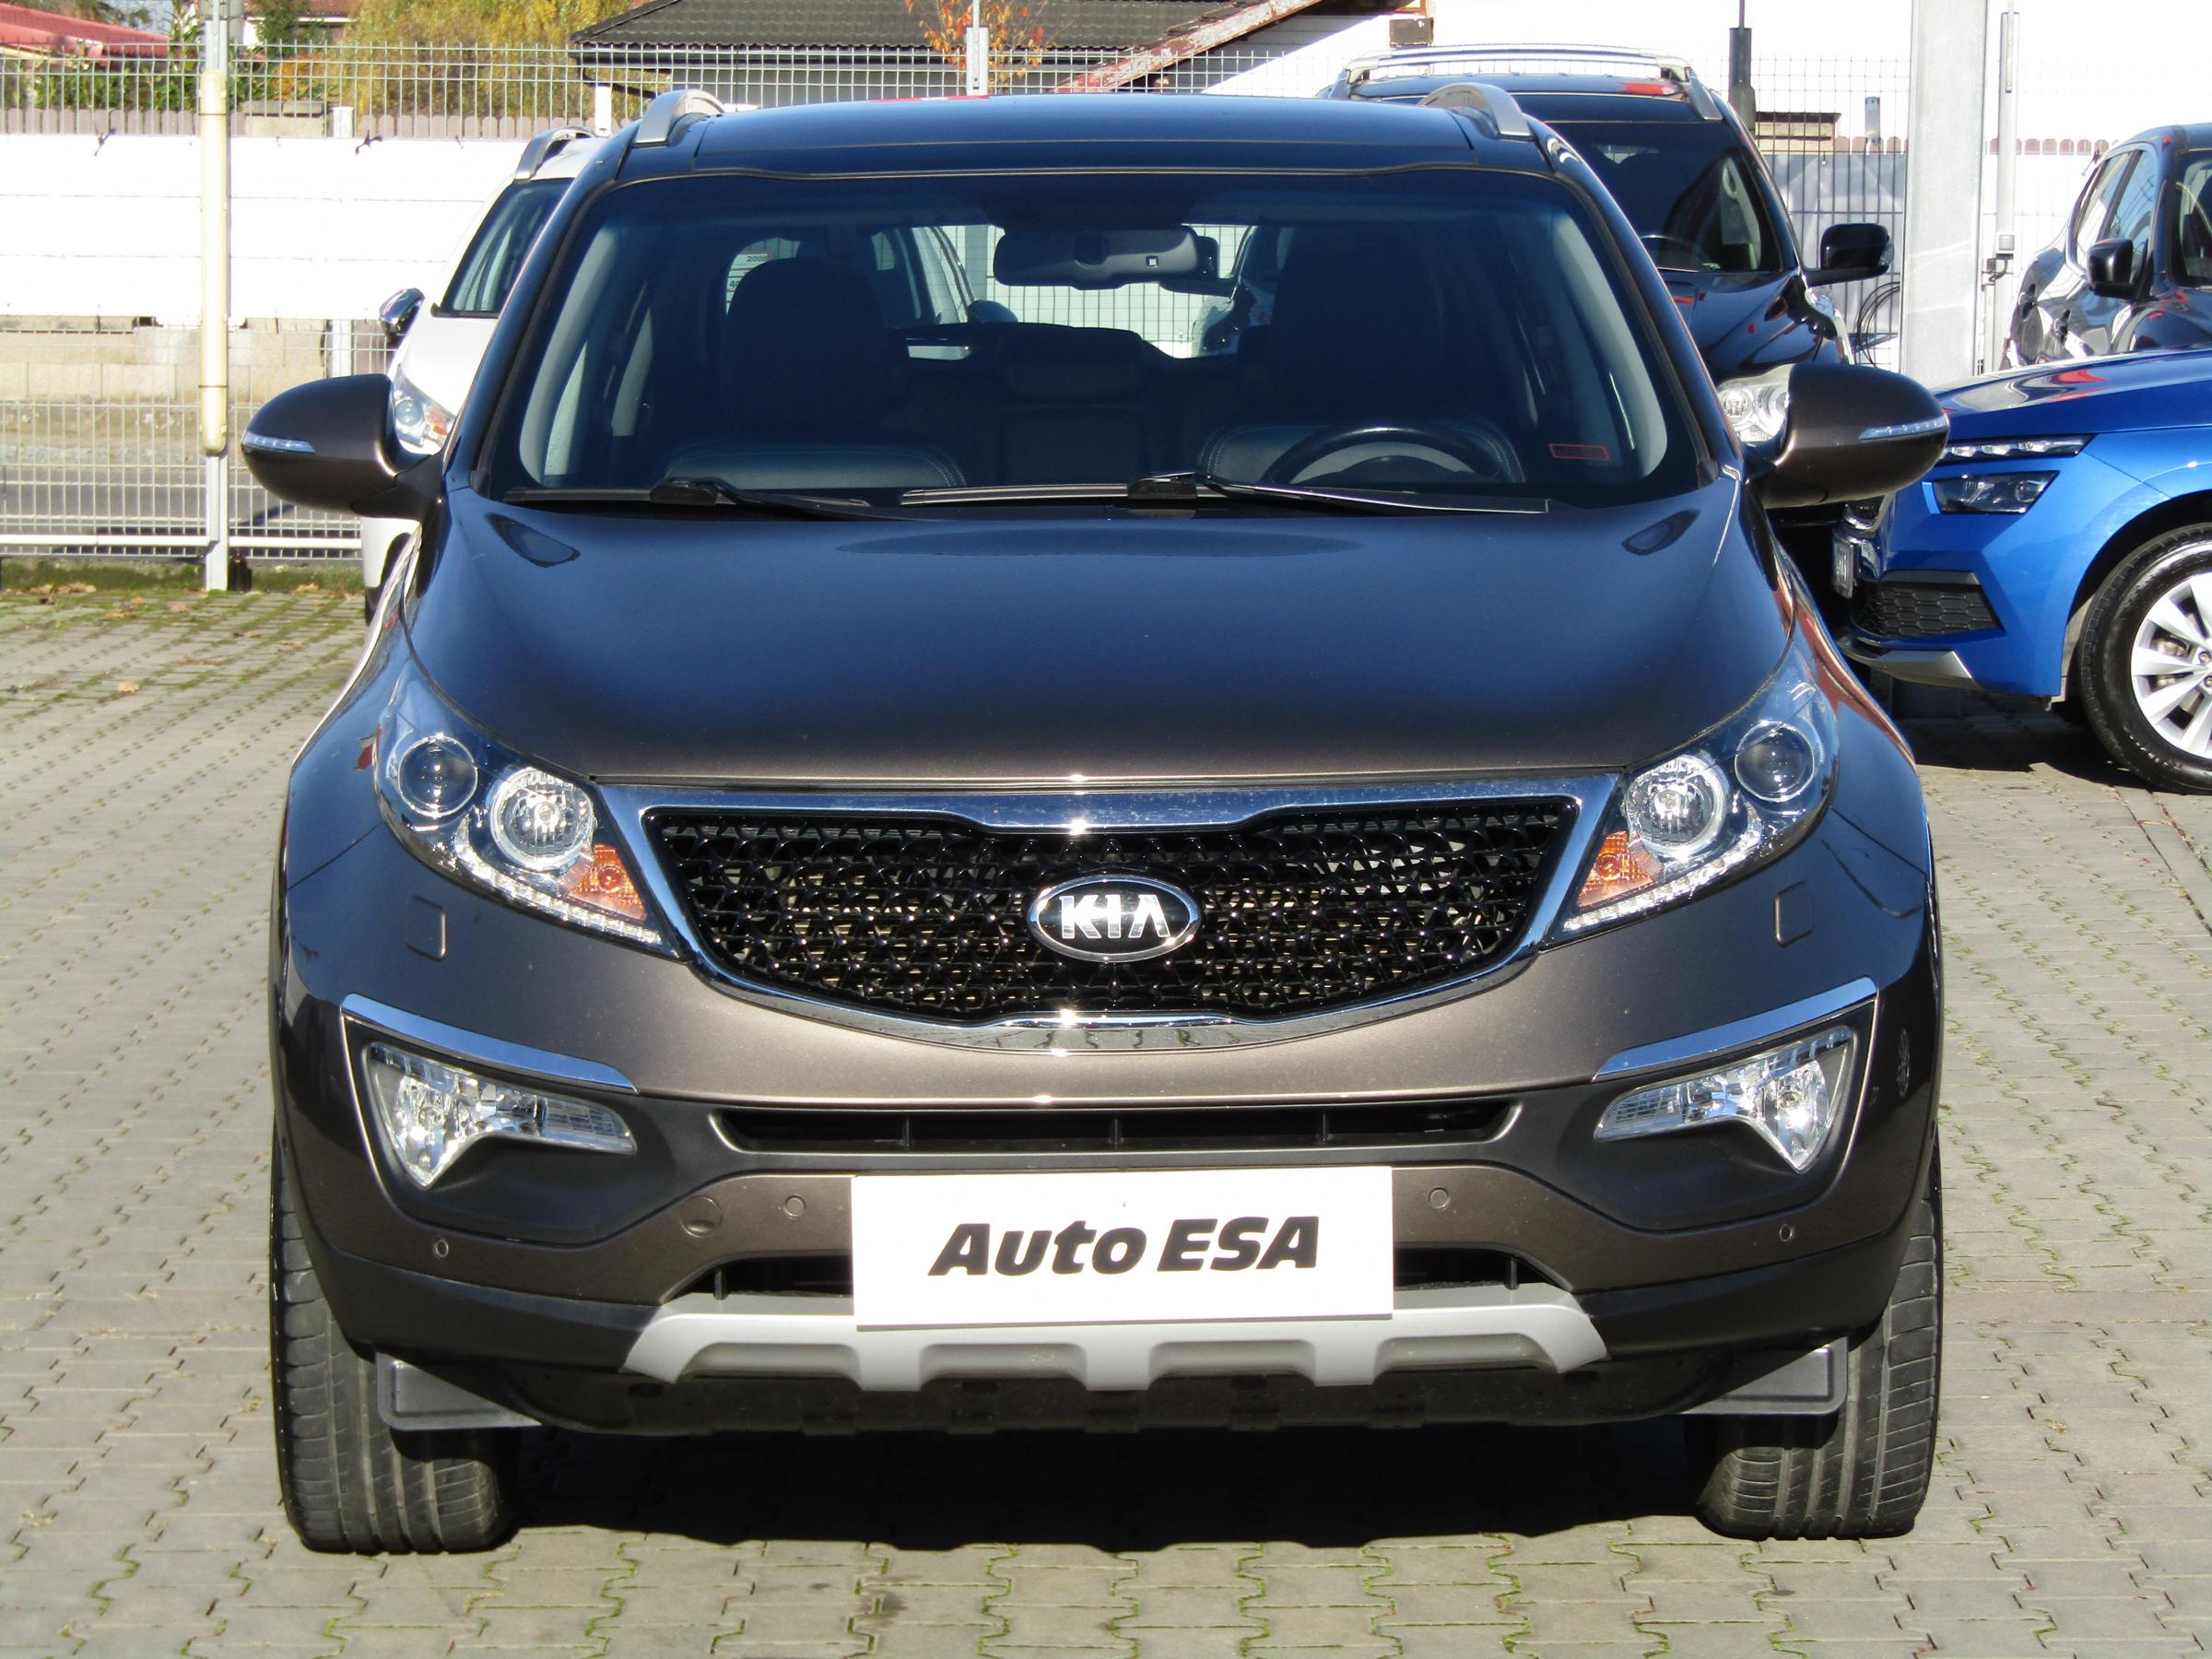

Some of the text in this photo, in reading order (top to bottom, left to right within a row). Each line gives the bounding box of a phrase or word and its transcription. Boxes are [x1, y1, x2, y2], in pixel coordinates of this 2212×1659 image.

[1059, 894, 1171, 939] KIA
[927, 1216, 1320, 1277] Auto ESA
